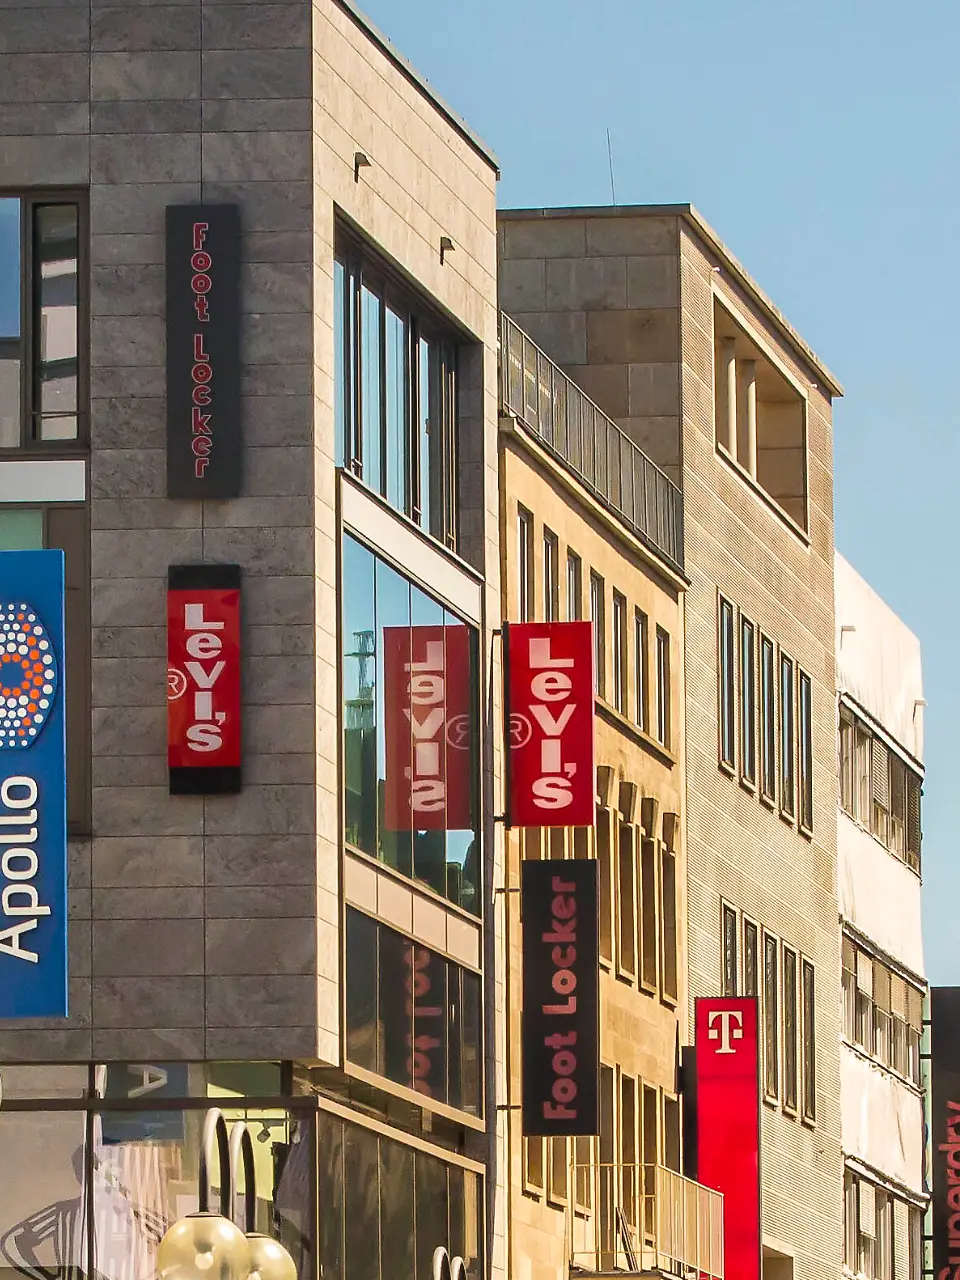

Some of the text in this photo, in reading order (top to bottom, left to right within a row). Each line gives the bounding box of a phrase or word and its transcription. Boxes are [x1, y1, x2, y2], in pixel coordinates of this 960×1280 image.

[191, 223, 213, 478] Foot Locker
[542, 876, 577, 1119] Foot Locker
